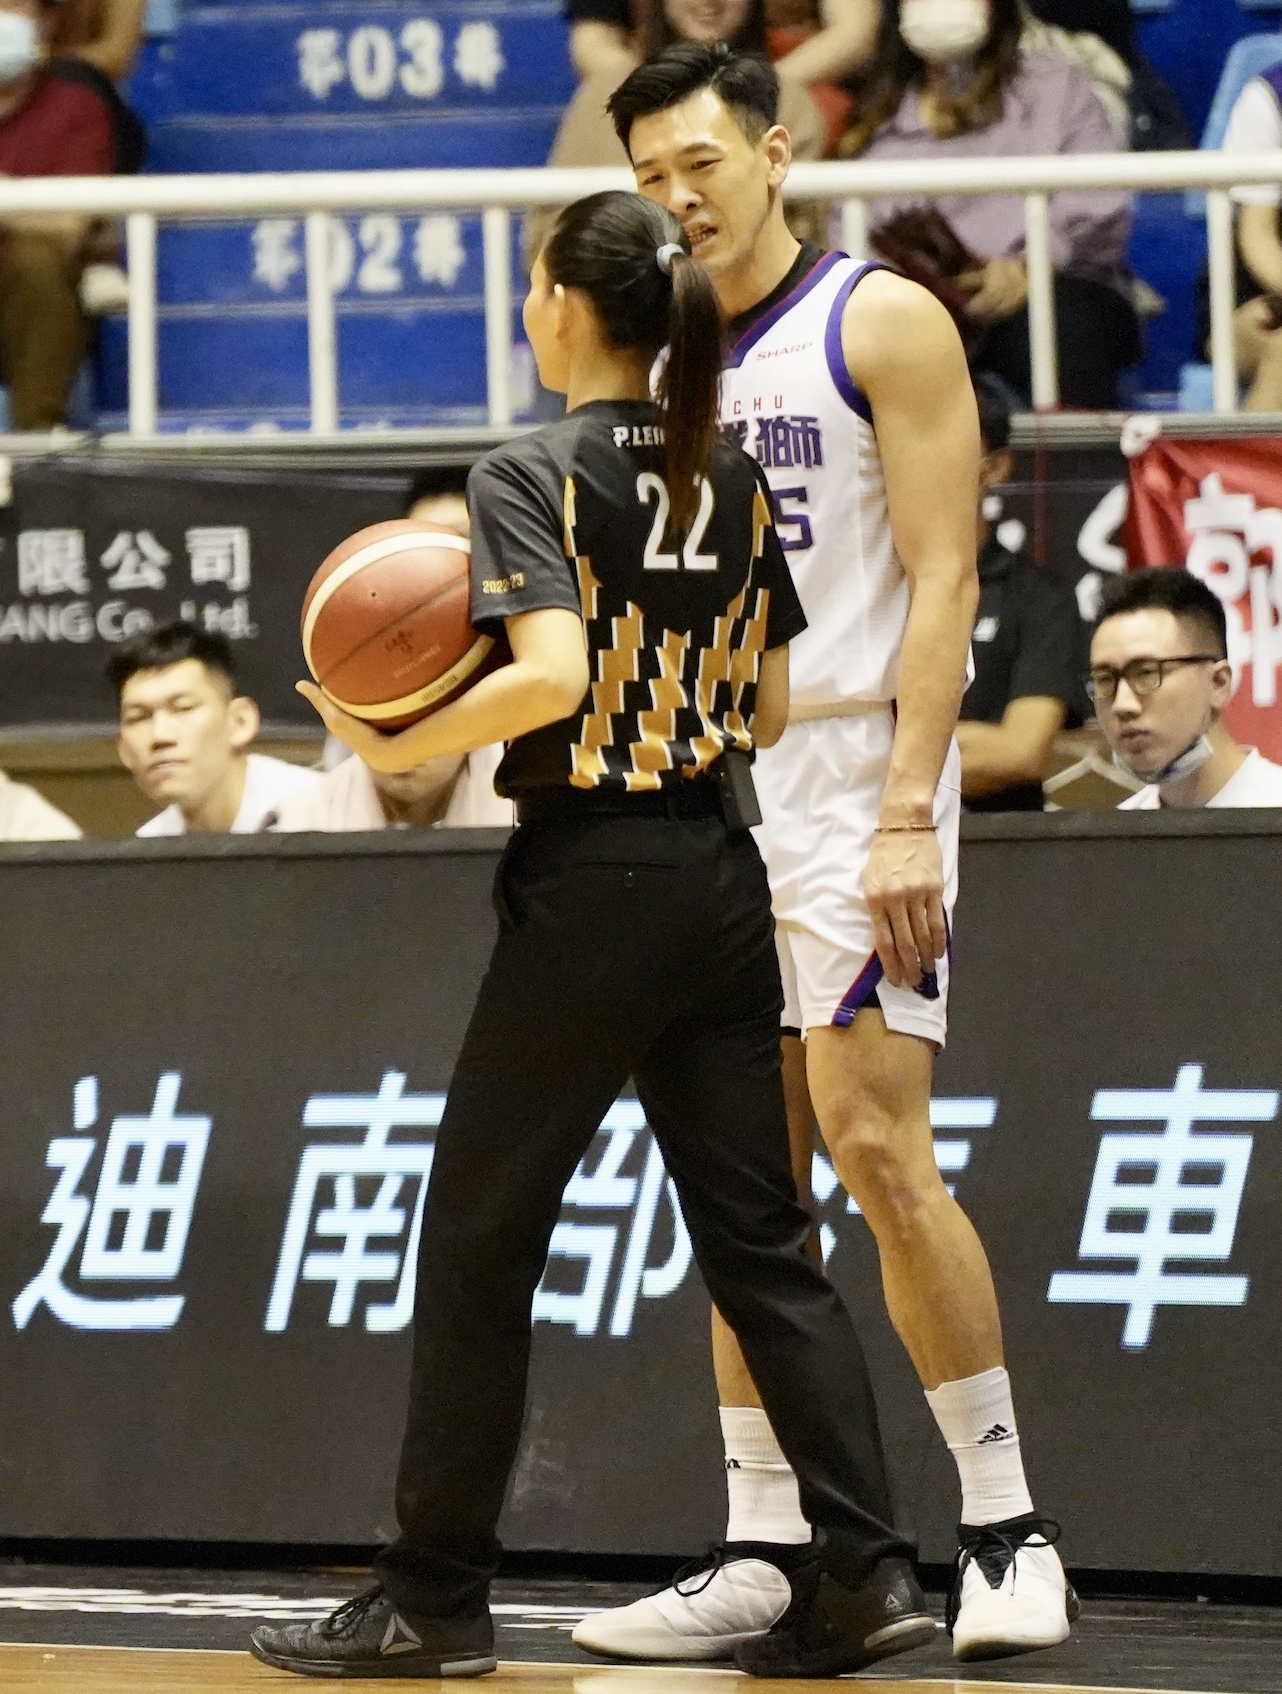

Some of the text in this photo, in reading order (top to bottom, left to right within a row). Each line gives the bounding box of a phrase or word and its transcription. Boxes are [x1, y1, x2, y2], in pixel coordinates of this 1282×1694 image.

[756, 342, 813, 361] SHARP
[719, 394, 783, 417] CHU
[721, 415, 824, 469] 獅
[636, 471, 717, 570] 22
